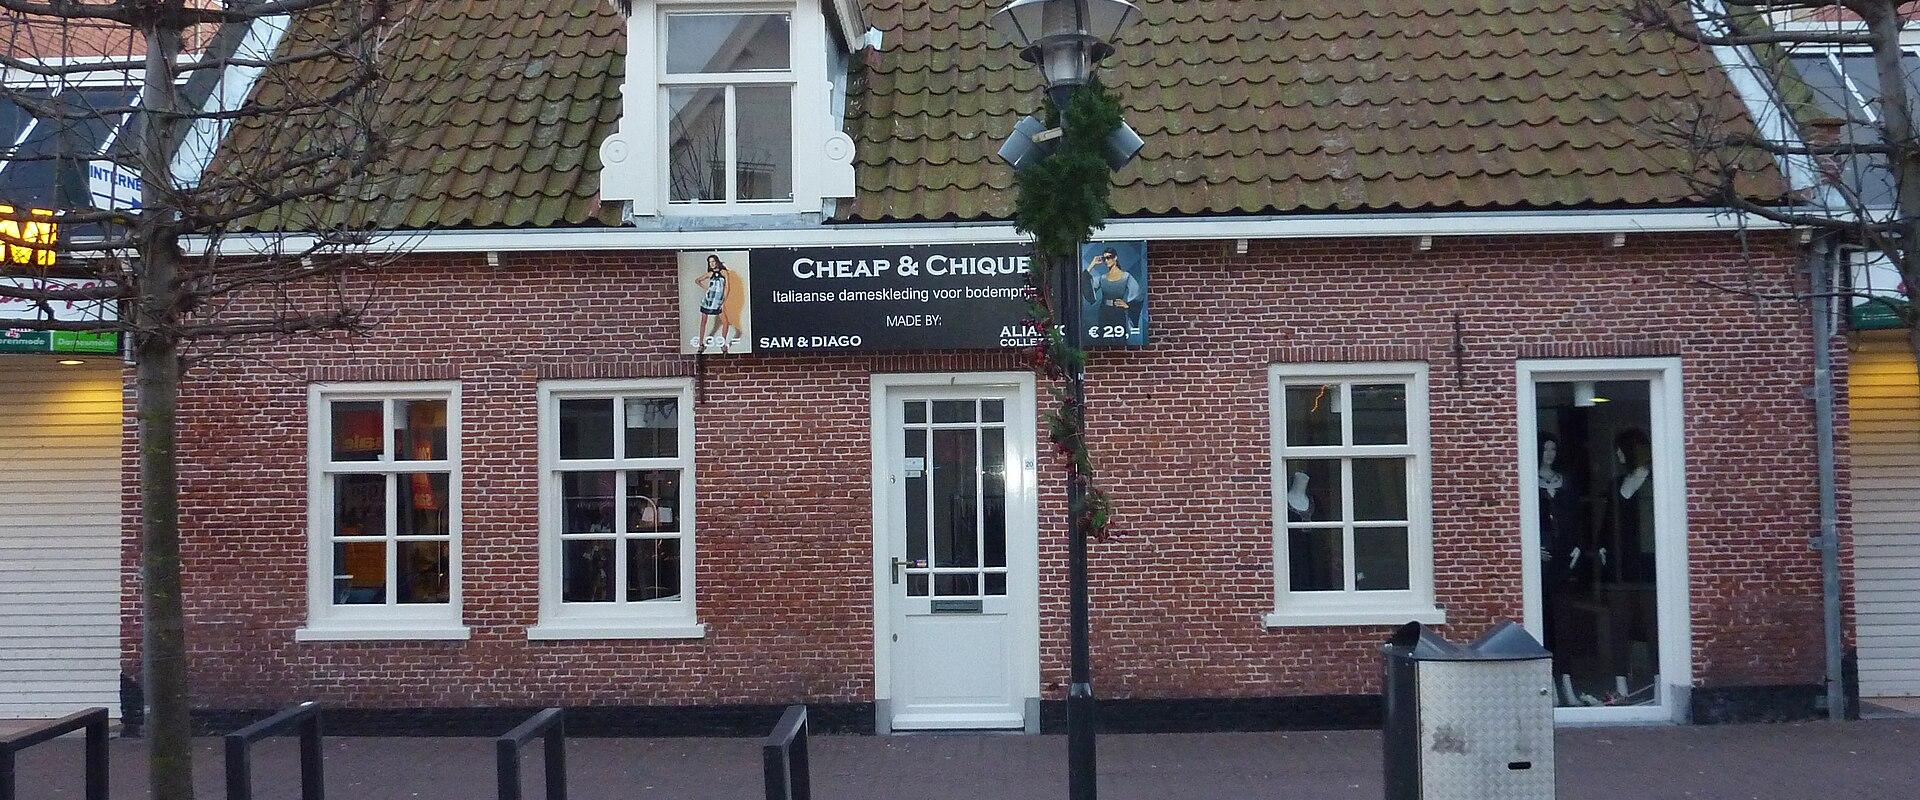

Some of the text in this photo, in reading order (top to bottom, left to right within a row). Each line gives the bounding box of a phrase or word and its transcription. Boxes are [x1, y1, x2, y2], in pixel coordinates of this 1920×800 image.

[90, 165, 142, 191] INTERNE
[792, 255, 1032, 279] CHEAP & CHIQUE
[772, 290, 835, 303] Italiaanse
[838, 287, 929, 302] dameskleding
[932, 288, 962, 299] voor
[886, 314, 942, 327] MADE BY:
[1088, 325, 1141, 340] € 29,=
[759, 335, 862, 348] SAM & DIAGO
